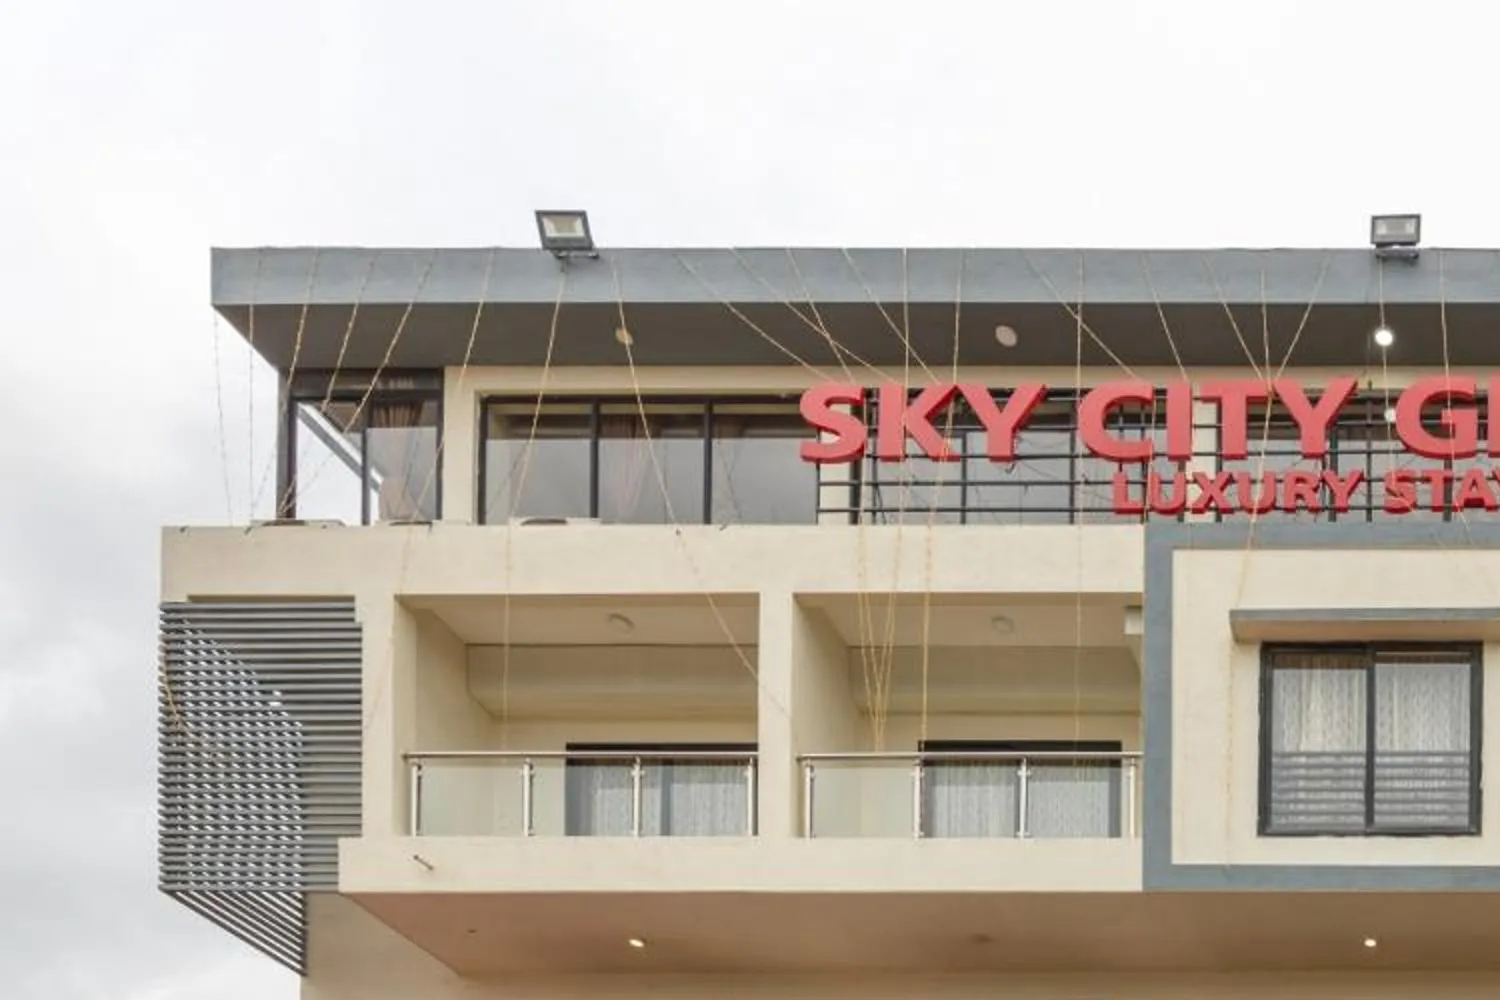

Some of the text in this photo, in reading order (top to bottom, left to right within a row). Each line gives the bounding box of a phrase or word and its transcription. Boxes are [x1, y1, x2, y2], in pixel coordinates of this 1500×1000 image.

[799, 378, 1049, 465] SKY
[1077, 374, 1358, 465] CITY
[1112, 469, 1366, 517] LUXURY
